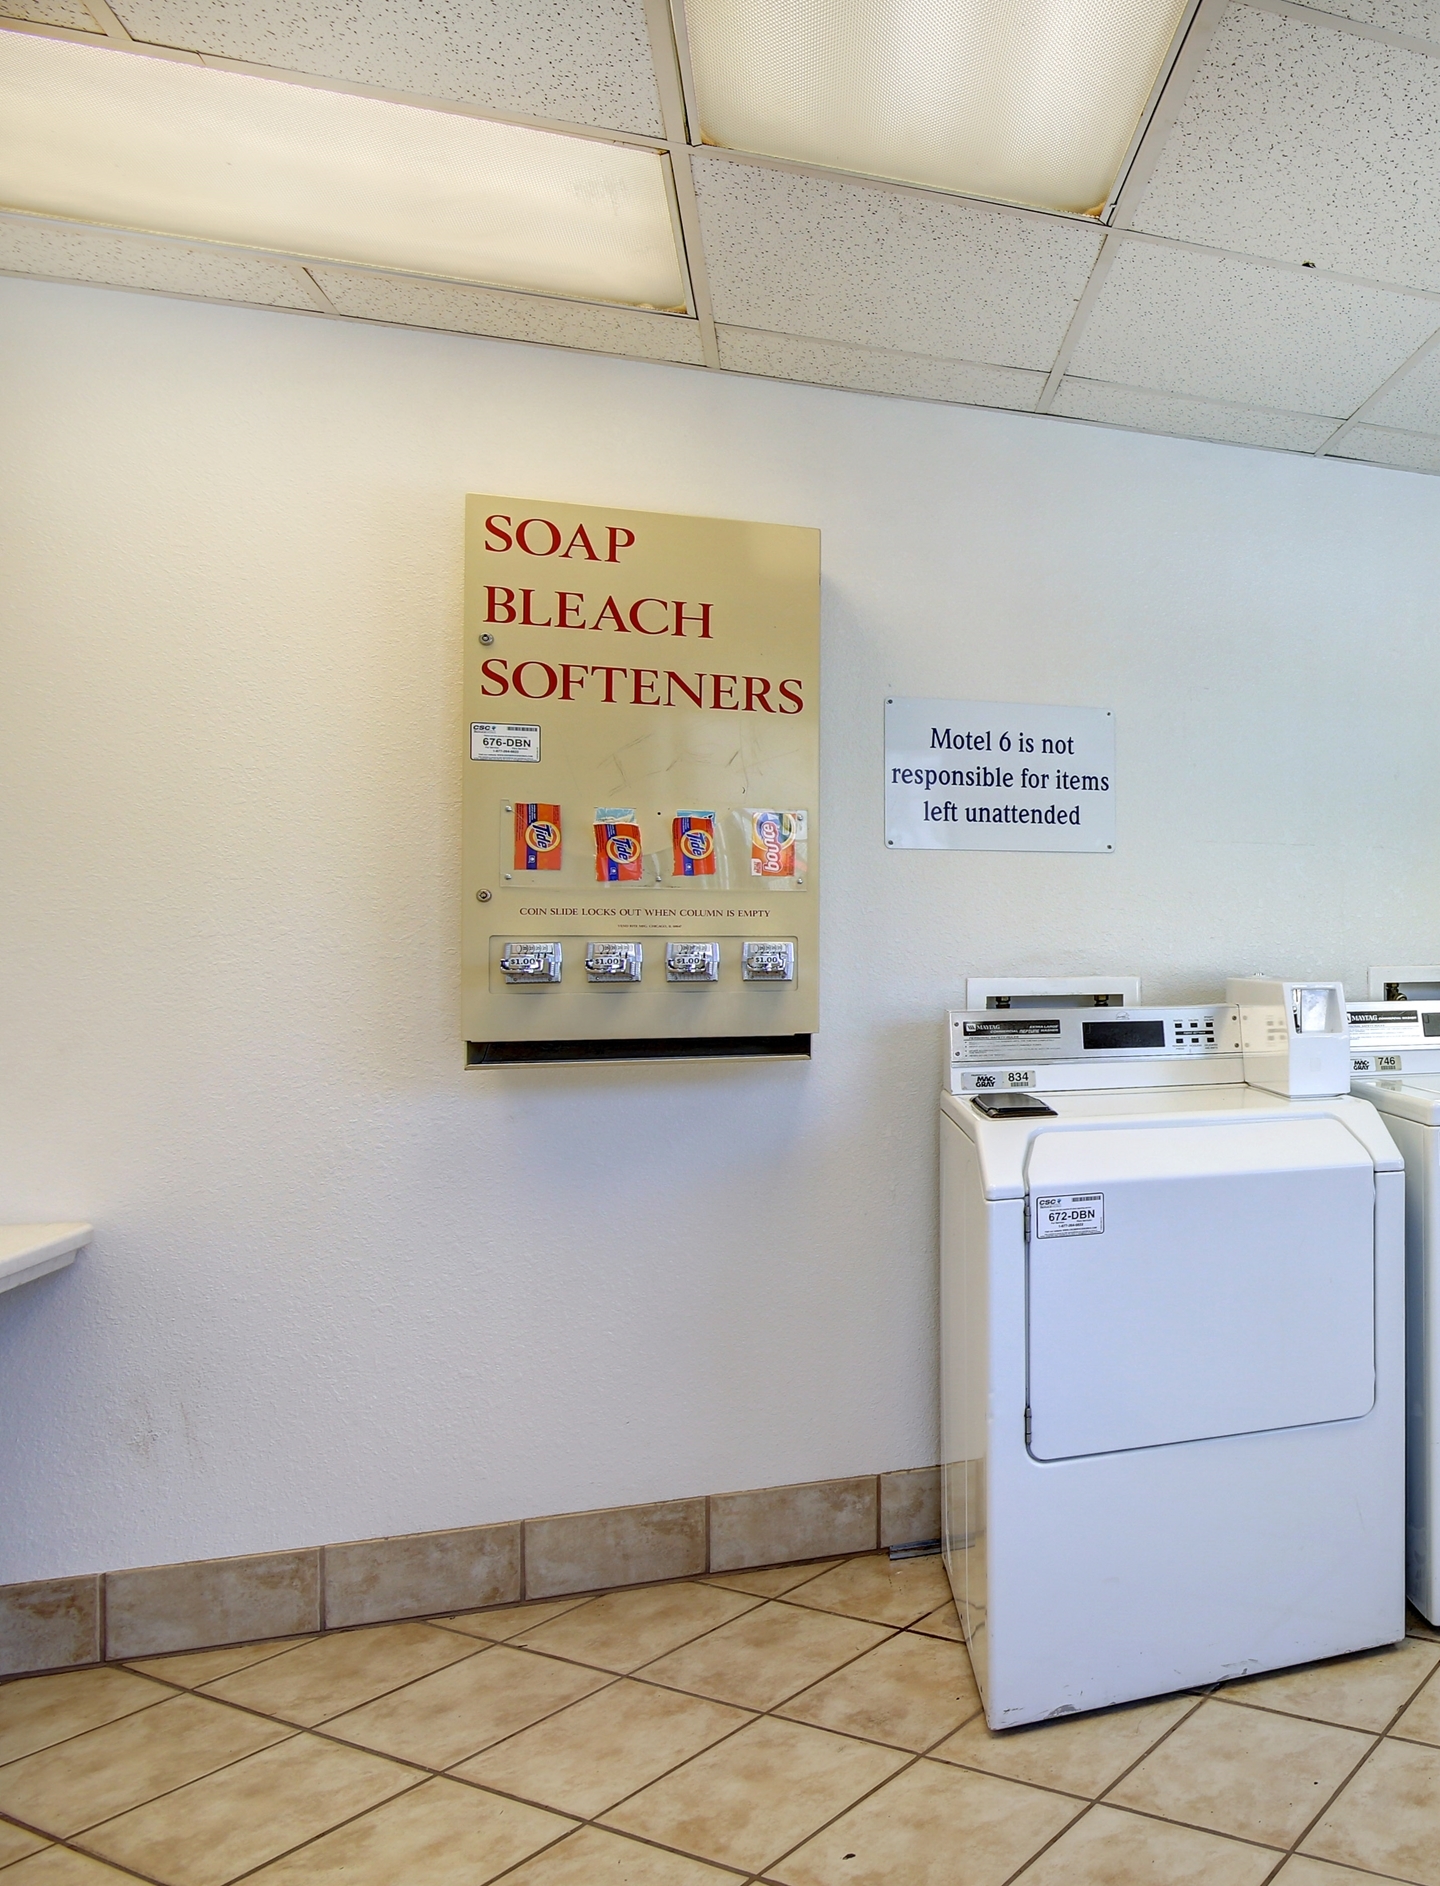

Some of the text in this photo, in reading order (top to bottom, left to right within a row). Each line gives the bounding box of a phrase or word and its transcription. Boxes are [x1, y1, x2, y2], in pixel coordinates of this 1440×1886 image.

[484, 514, 636, 563] SOAP
[482, 585, 714, 639] BLEACH
[480, 658, 804, 715] SOFTENERS
[482, 737, 531, 748] 676-DBN
[930, 727, 1075, 755] Motel 6 is not
[891, 766, 1110, 791] responsible for items
[923, 800, 1081, 825] left unattended
[532, 823, 553, 849] Tide
[686, 832, 707, 857] Tide
[764, 823, 780, 872] bounce
[611, 838, 632, 862] Tide
[519, 907, 771, 917] COIN SLIDE LOCKS OUT WHEN COLUMN IS EMPTY
[1378, 1056, 1396, 1065] 746
[1008, 1072, 1029, 1082] 834
[1039, 1198, 1057, 1206] CSC
[1048, 1209, 1095, 1222] 672-DBN
